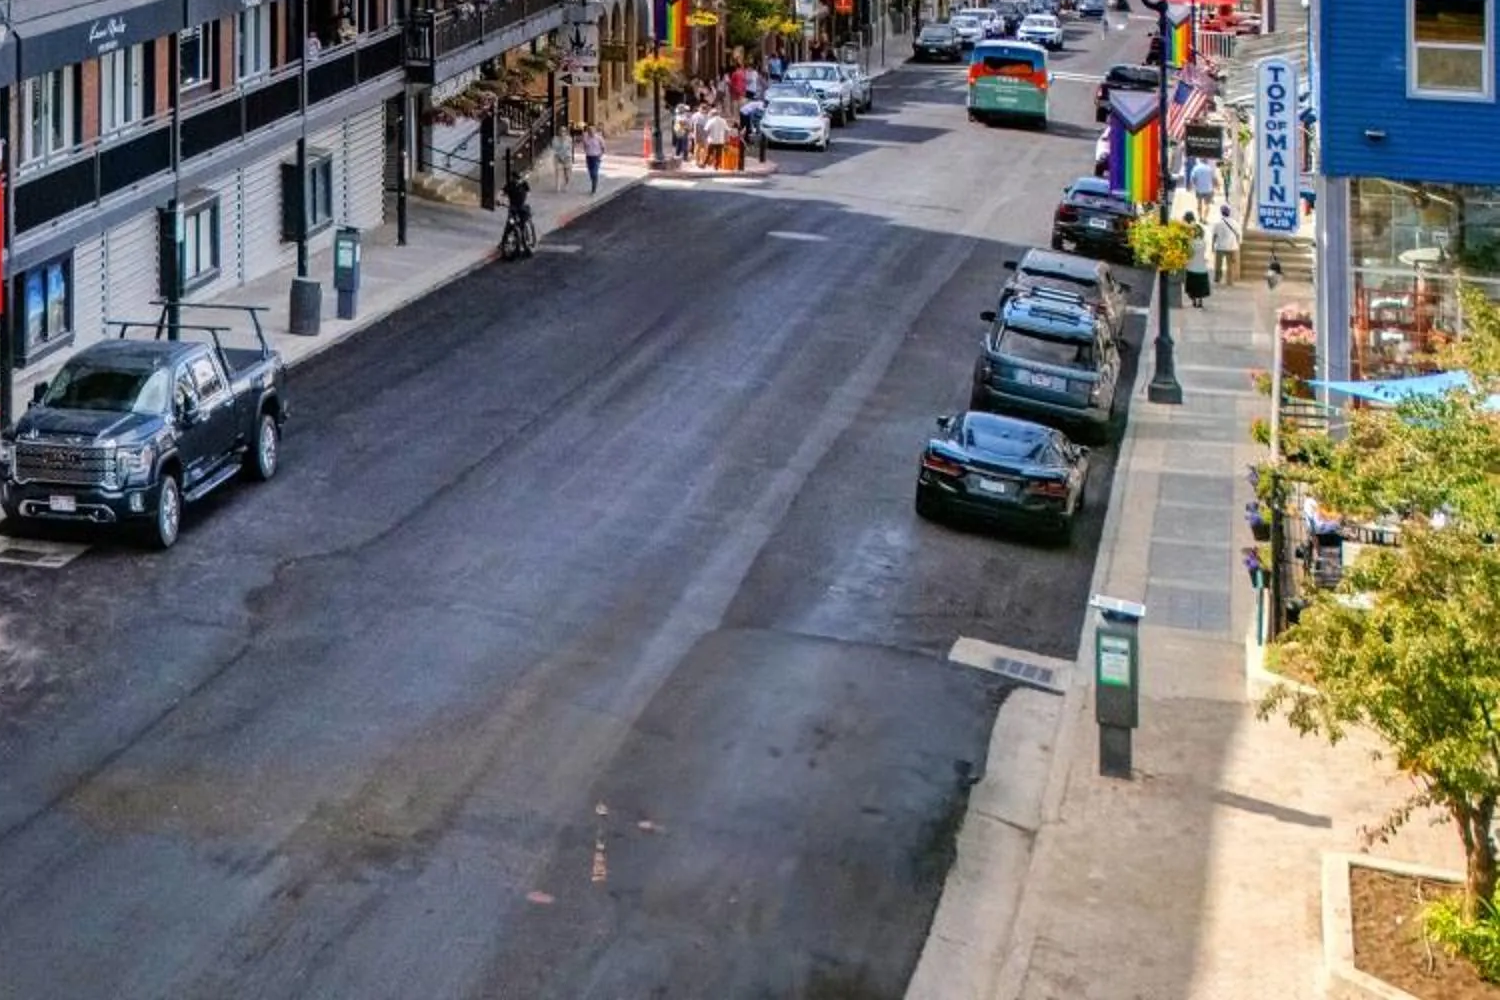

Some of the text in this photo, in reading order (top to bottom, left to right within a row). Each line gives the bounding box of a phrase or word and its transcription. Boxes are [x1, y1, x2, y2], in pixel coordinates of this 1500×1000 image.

[1266, 66, 1288, 202] TOP OF MAIN
[1260, 208, 1296, 219] BREW
[1265, 217, 1291, 228] PUB
